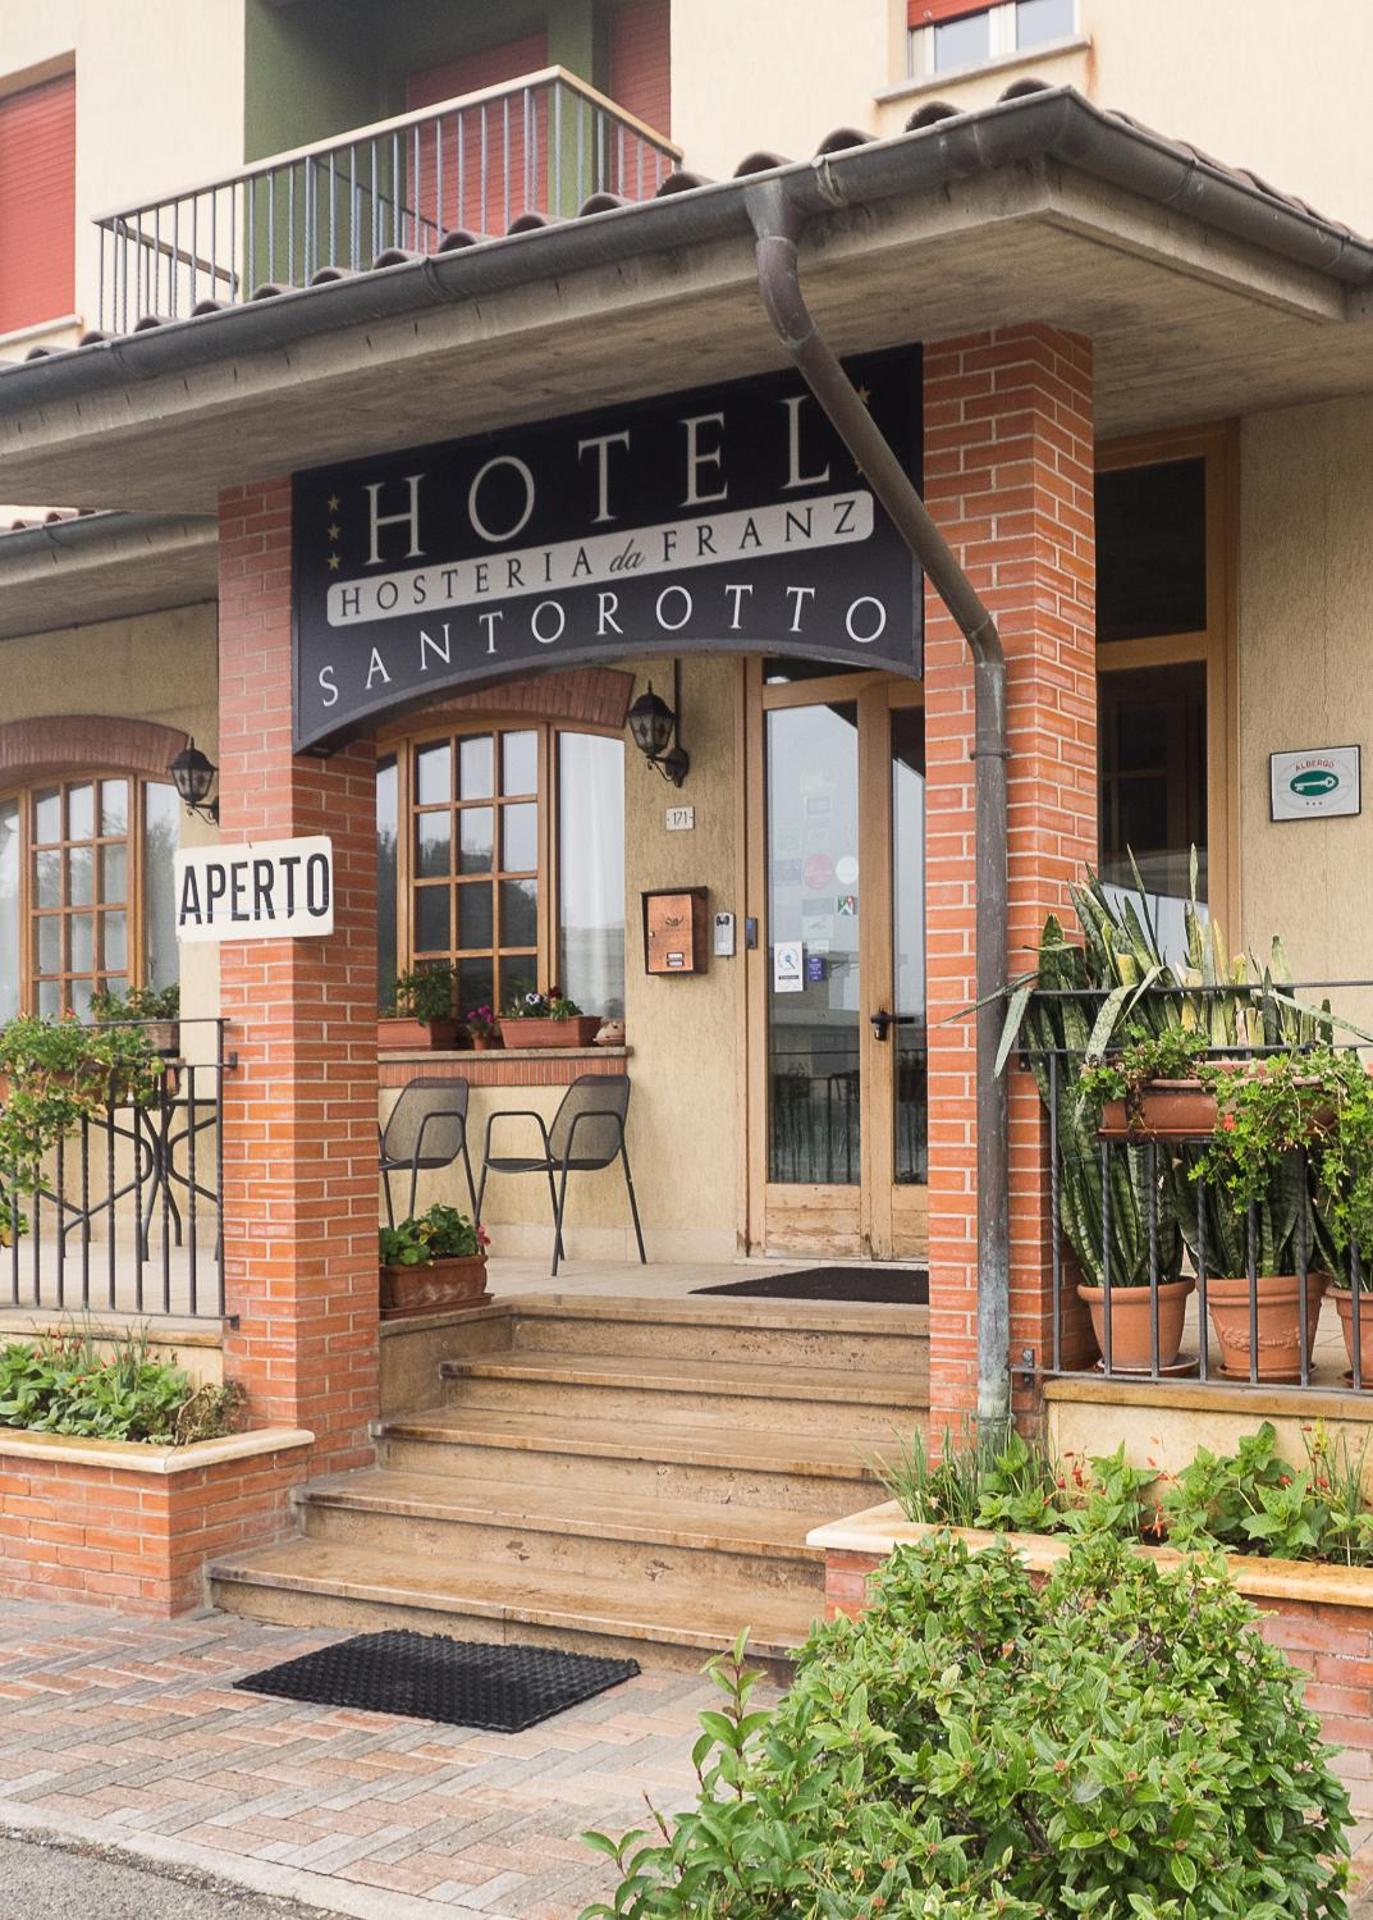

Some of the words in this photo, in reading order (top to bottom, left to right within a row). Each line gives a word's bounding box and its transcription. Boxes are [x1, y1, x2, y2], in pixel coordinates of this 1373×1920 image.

[363, 395, 831, 567] HOTEL
[340, 546, 593, 618] HOSTERIA
[608, 539, 646, 572] da
[662, 500, 857, 562] FRANZ
[318, 584, 887, 707] SANTOROTTO
[672, 811, 688, 825] 171
[179, 852, 330, 926] APERTO
